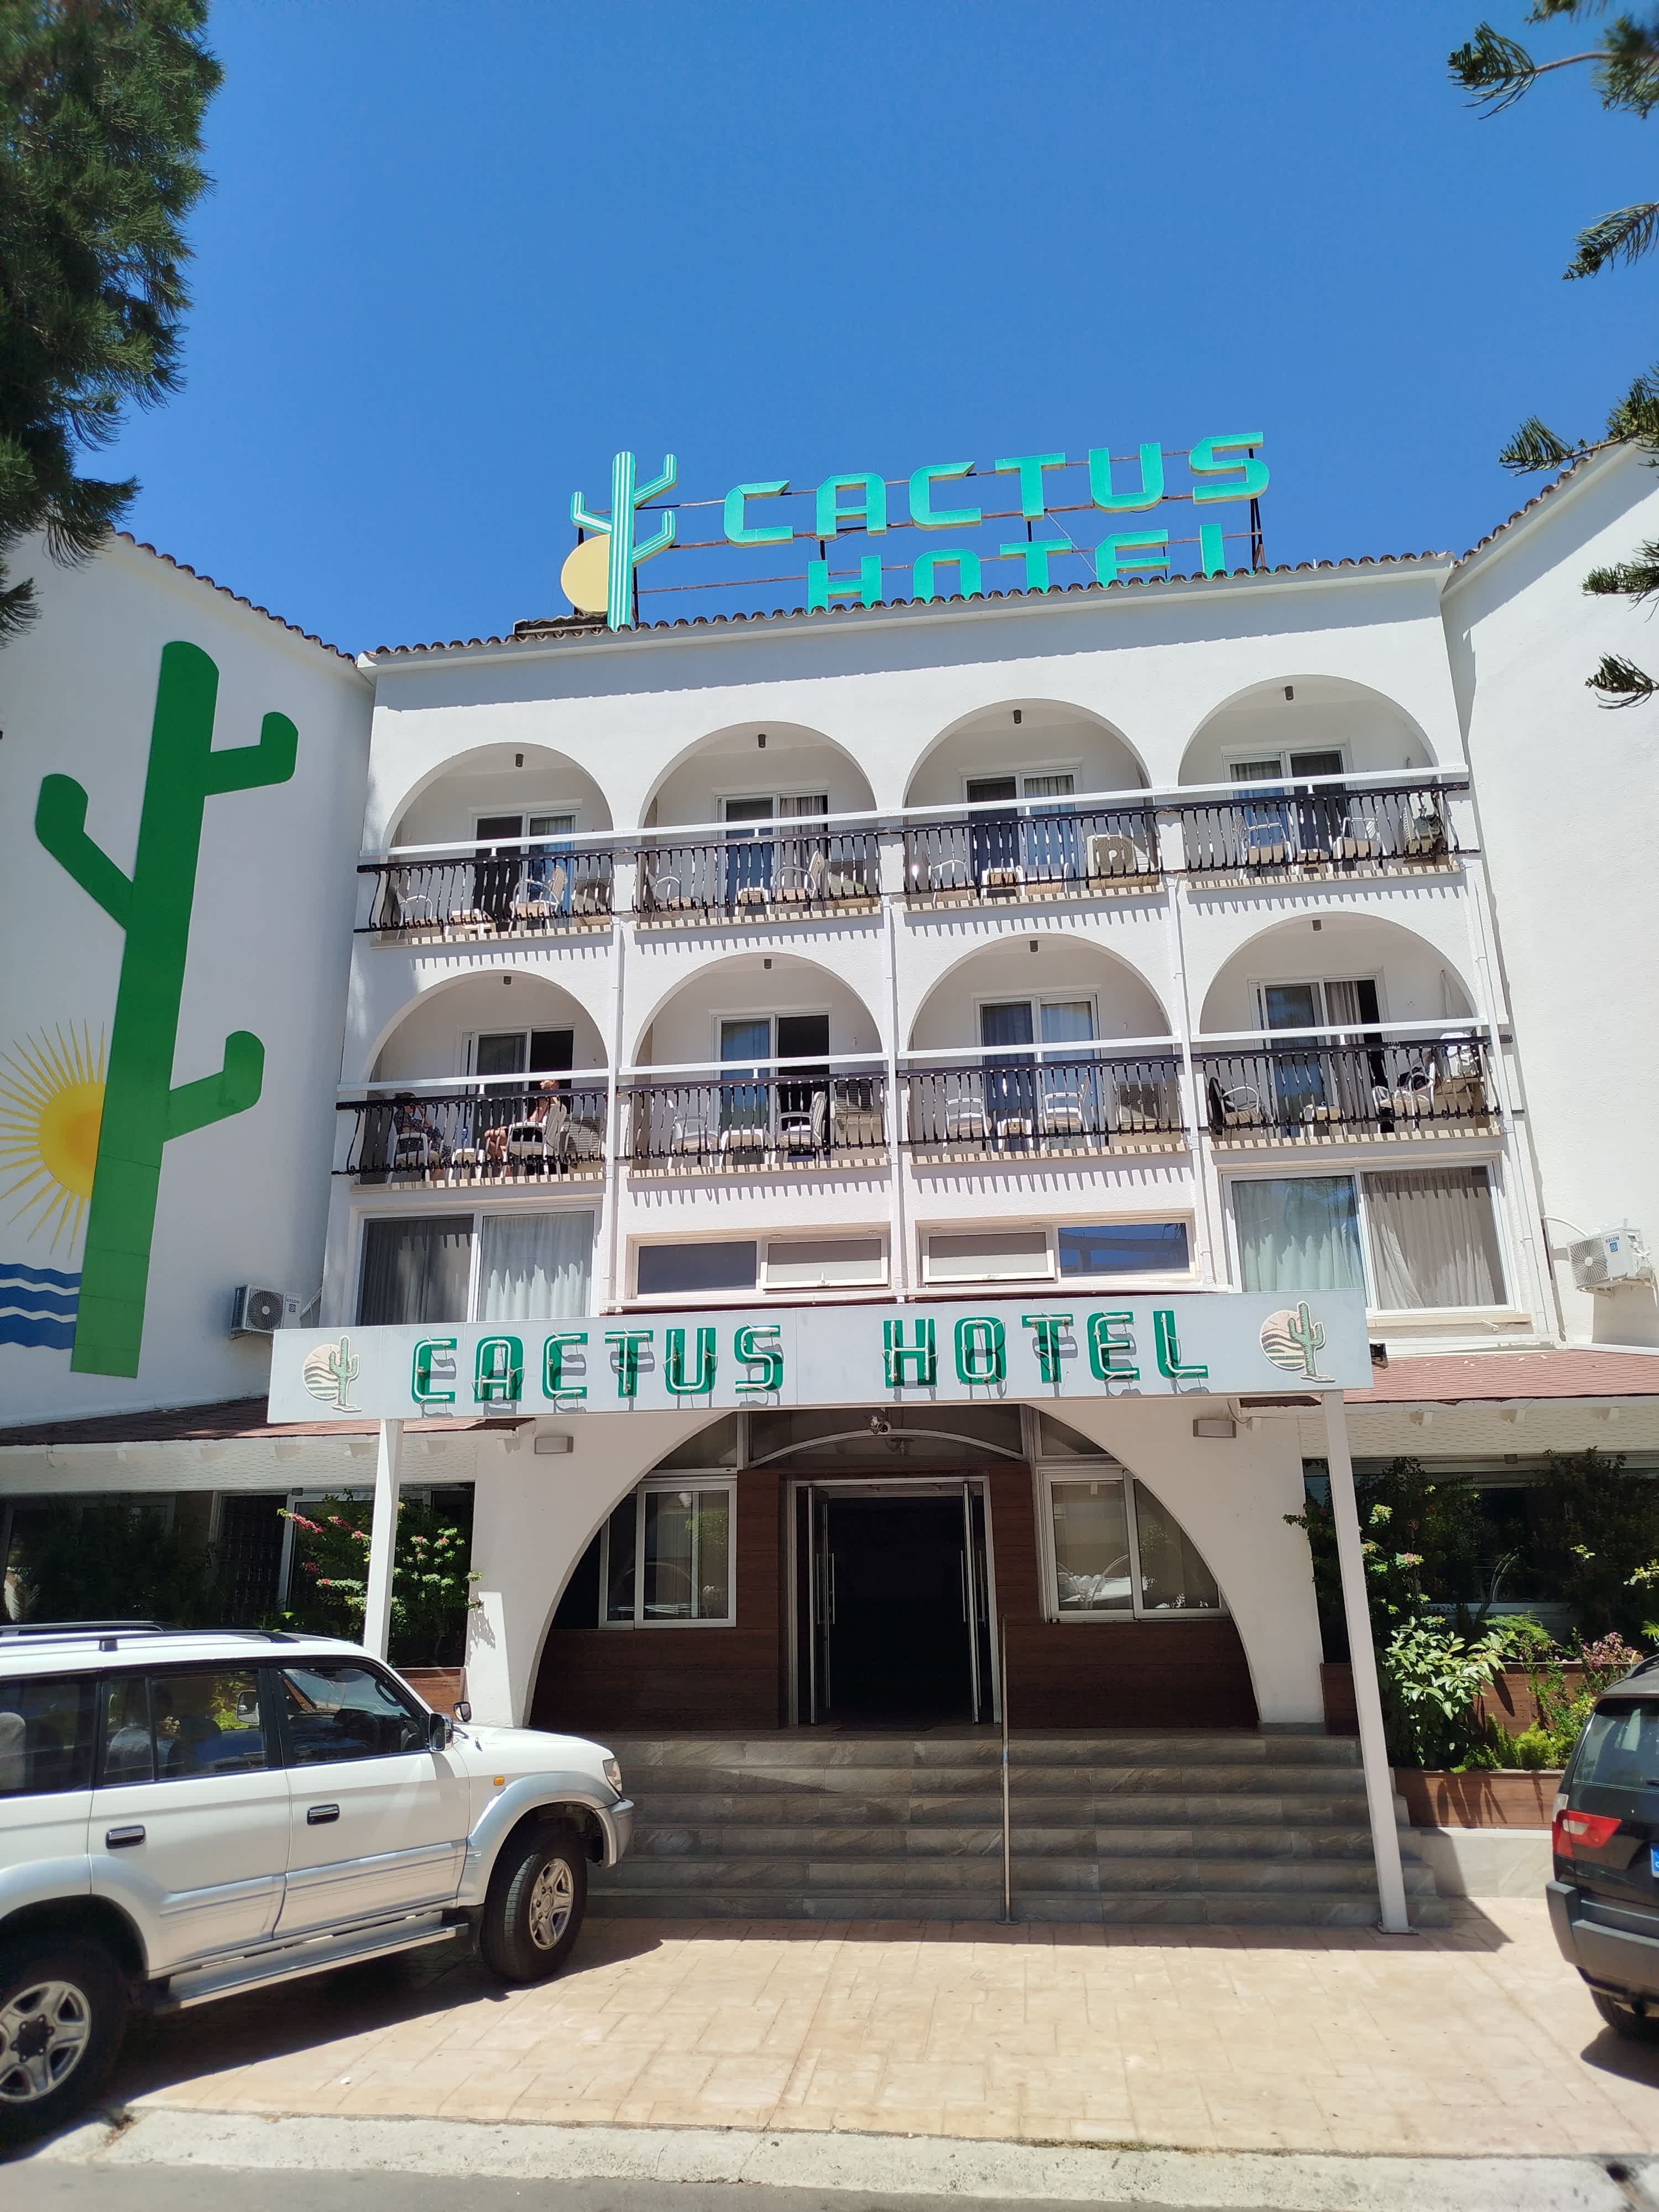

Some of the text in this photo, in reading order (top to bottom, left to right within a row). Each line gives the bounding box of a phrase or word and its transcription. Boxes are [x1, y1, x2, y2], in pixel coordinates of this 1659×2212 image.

[724, 432, 1271, 545] CACTUS
[1605, 1235, 1619, 1244] KELON
[411, 1310, 1209, 1405] CACTUS HOTEL
